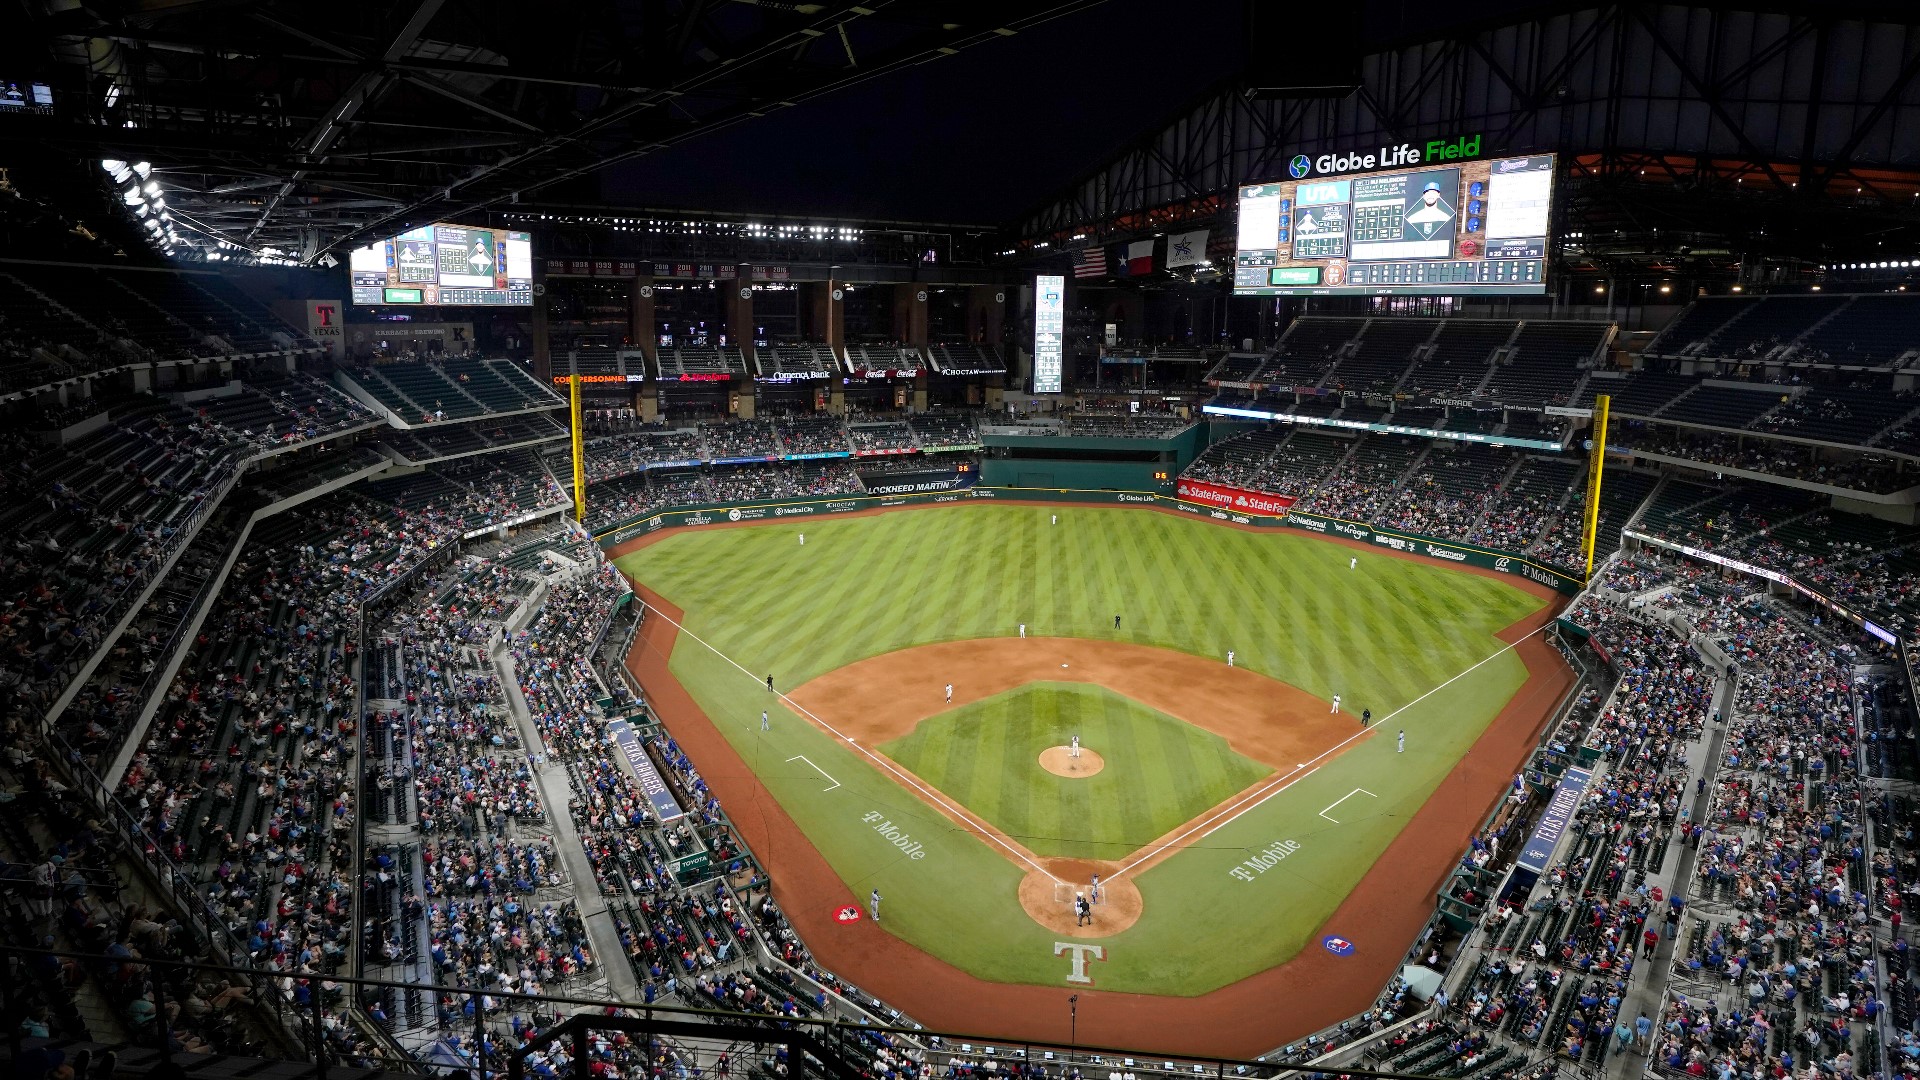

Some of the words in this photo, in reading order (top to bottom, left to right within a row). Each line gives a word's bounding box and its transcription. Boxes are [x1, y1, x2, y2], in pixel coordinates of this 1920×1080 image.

[1315, 152, 1376, 174] Globe
[1380, 143, 1421, 167] Life
[1425, 134, 1481, 161] Field
[1306, 185, 1339, 201] UTA
[642, 288, 651, 296] 34
[741, 289, 751, 297] 26
[316, 306, 335, 326] T
[452, 327, 465, 341] K
[553, 376, 571, 384] COR
[579, 375, 627, 383] PERSONNEL
[865, 370, 887, 378] Coca-Cola
[896, 369, 917, 378] Coca-Cola
[1430, 398, 1473, 407] POWERADE
[868, 484, 915, 495] LOCKHEED
[916, 481, 950, 490] MARTIN
[803, 506, 814, 514] City
[1249, 498, 1289, 515] StateFar
[649, 517, 662, 526] UTA
[1296, 516, 1327, 529] National
[1344, 523, 1369, 540] Kroger
[1376, 535, 1389, 545] BIG
[1389, 538, 1406, 548] BITE
[1530, 568, 1559, 588] Mobile
[622, 741, 645, 762] TEXAS
[635, 762, 665, 795] RANGERS
[1535, 817, 1563, 843] TEXAS
[1549, 788, 1579, 820] RANGERS
[873, 820, 926, 861] Mobile
[682, 855, 708, 867] TOYOTA
[1243, 839, 1301, 874] Mobile
[1054, 942, 1106, 985] T
